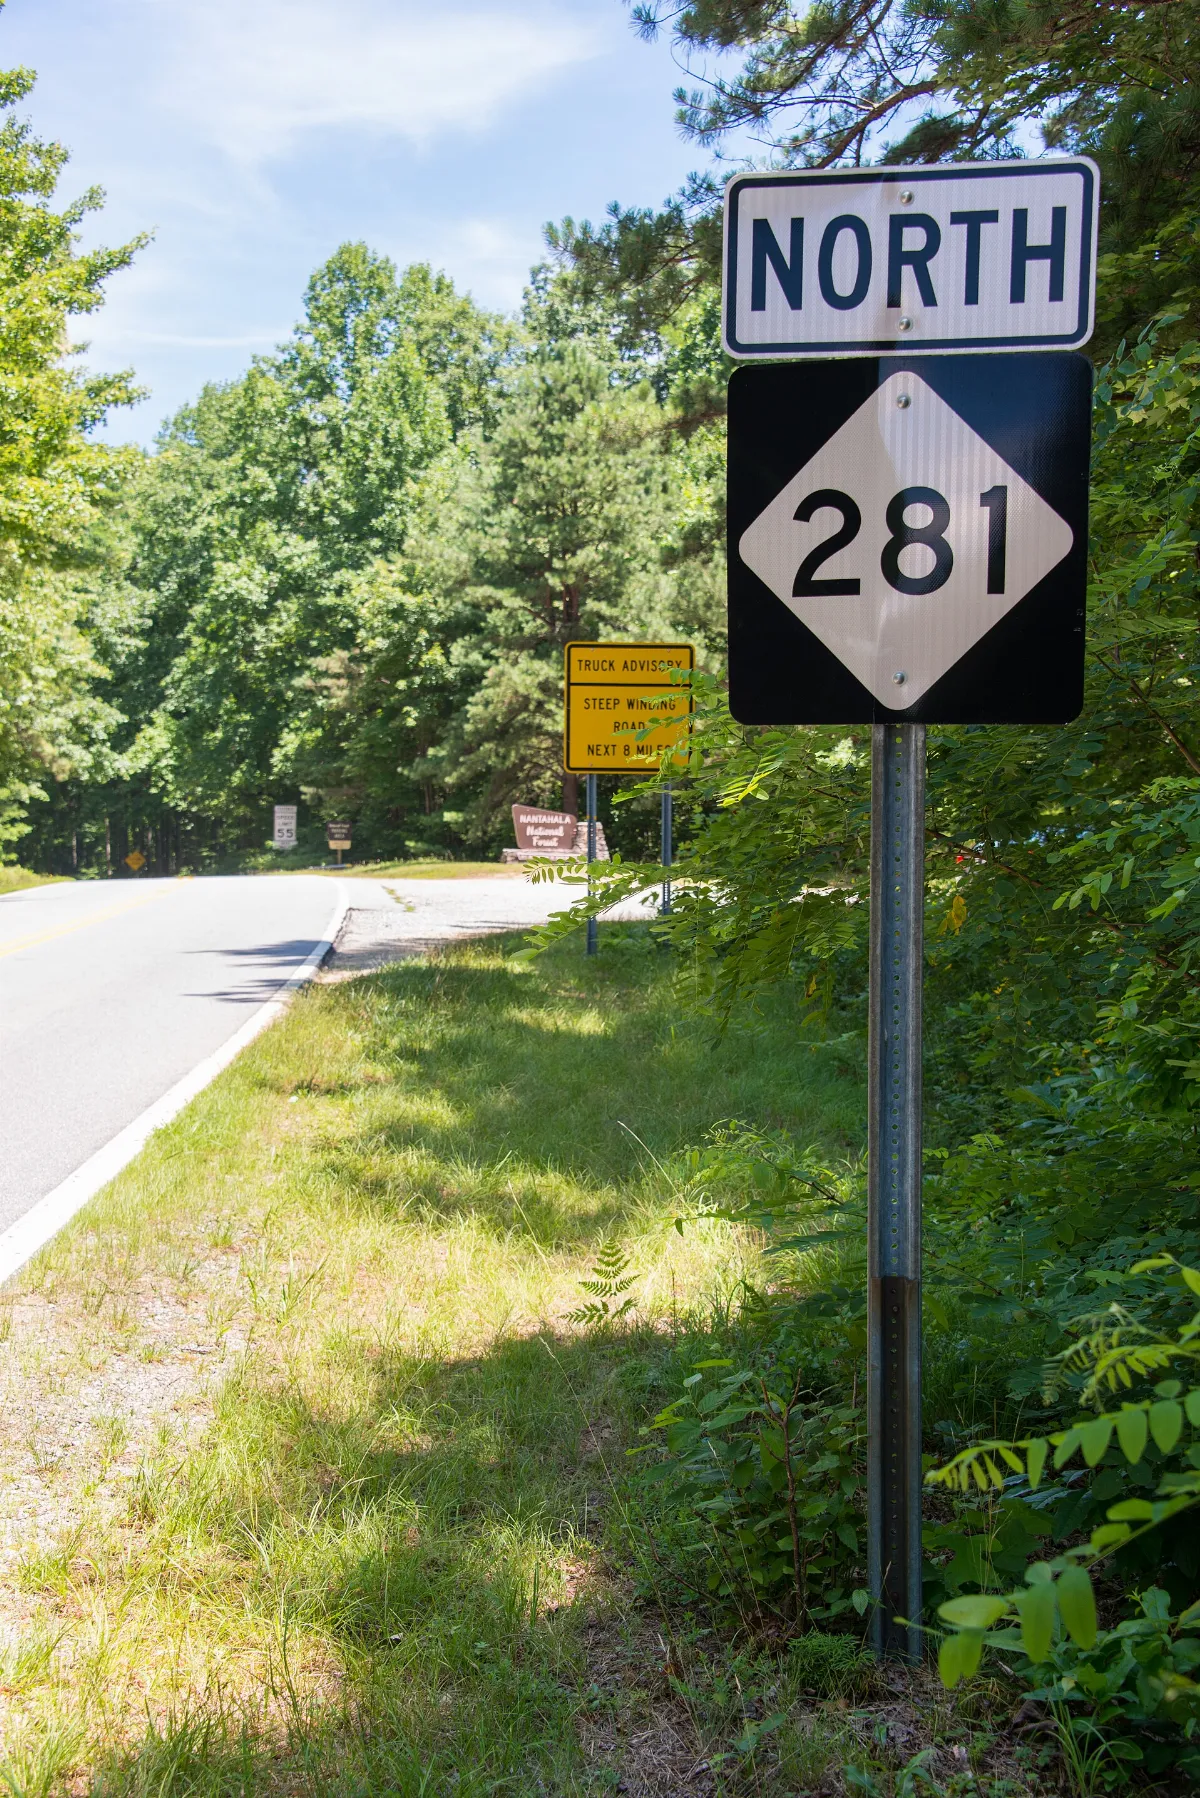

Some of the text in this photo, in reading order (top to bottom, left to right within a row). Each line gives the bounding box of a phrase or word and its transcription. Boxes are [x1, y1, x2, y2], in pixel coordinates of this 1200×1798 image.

[751, 206, 1067, 311] NORTH
[792, 485, 1009, 598] 281
[577, 659, 683, 672] TRUCK ADVISORY
[584, 698, 620, 710] STEEP
[613, 721, 646, 733] ROAD
[587, 744, 673, 757] NEXT 8 MILE
[519, 813, 571, 824] NANTAHALA
[277, 828, 294, 839] 55
